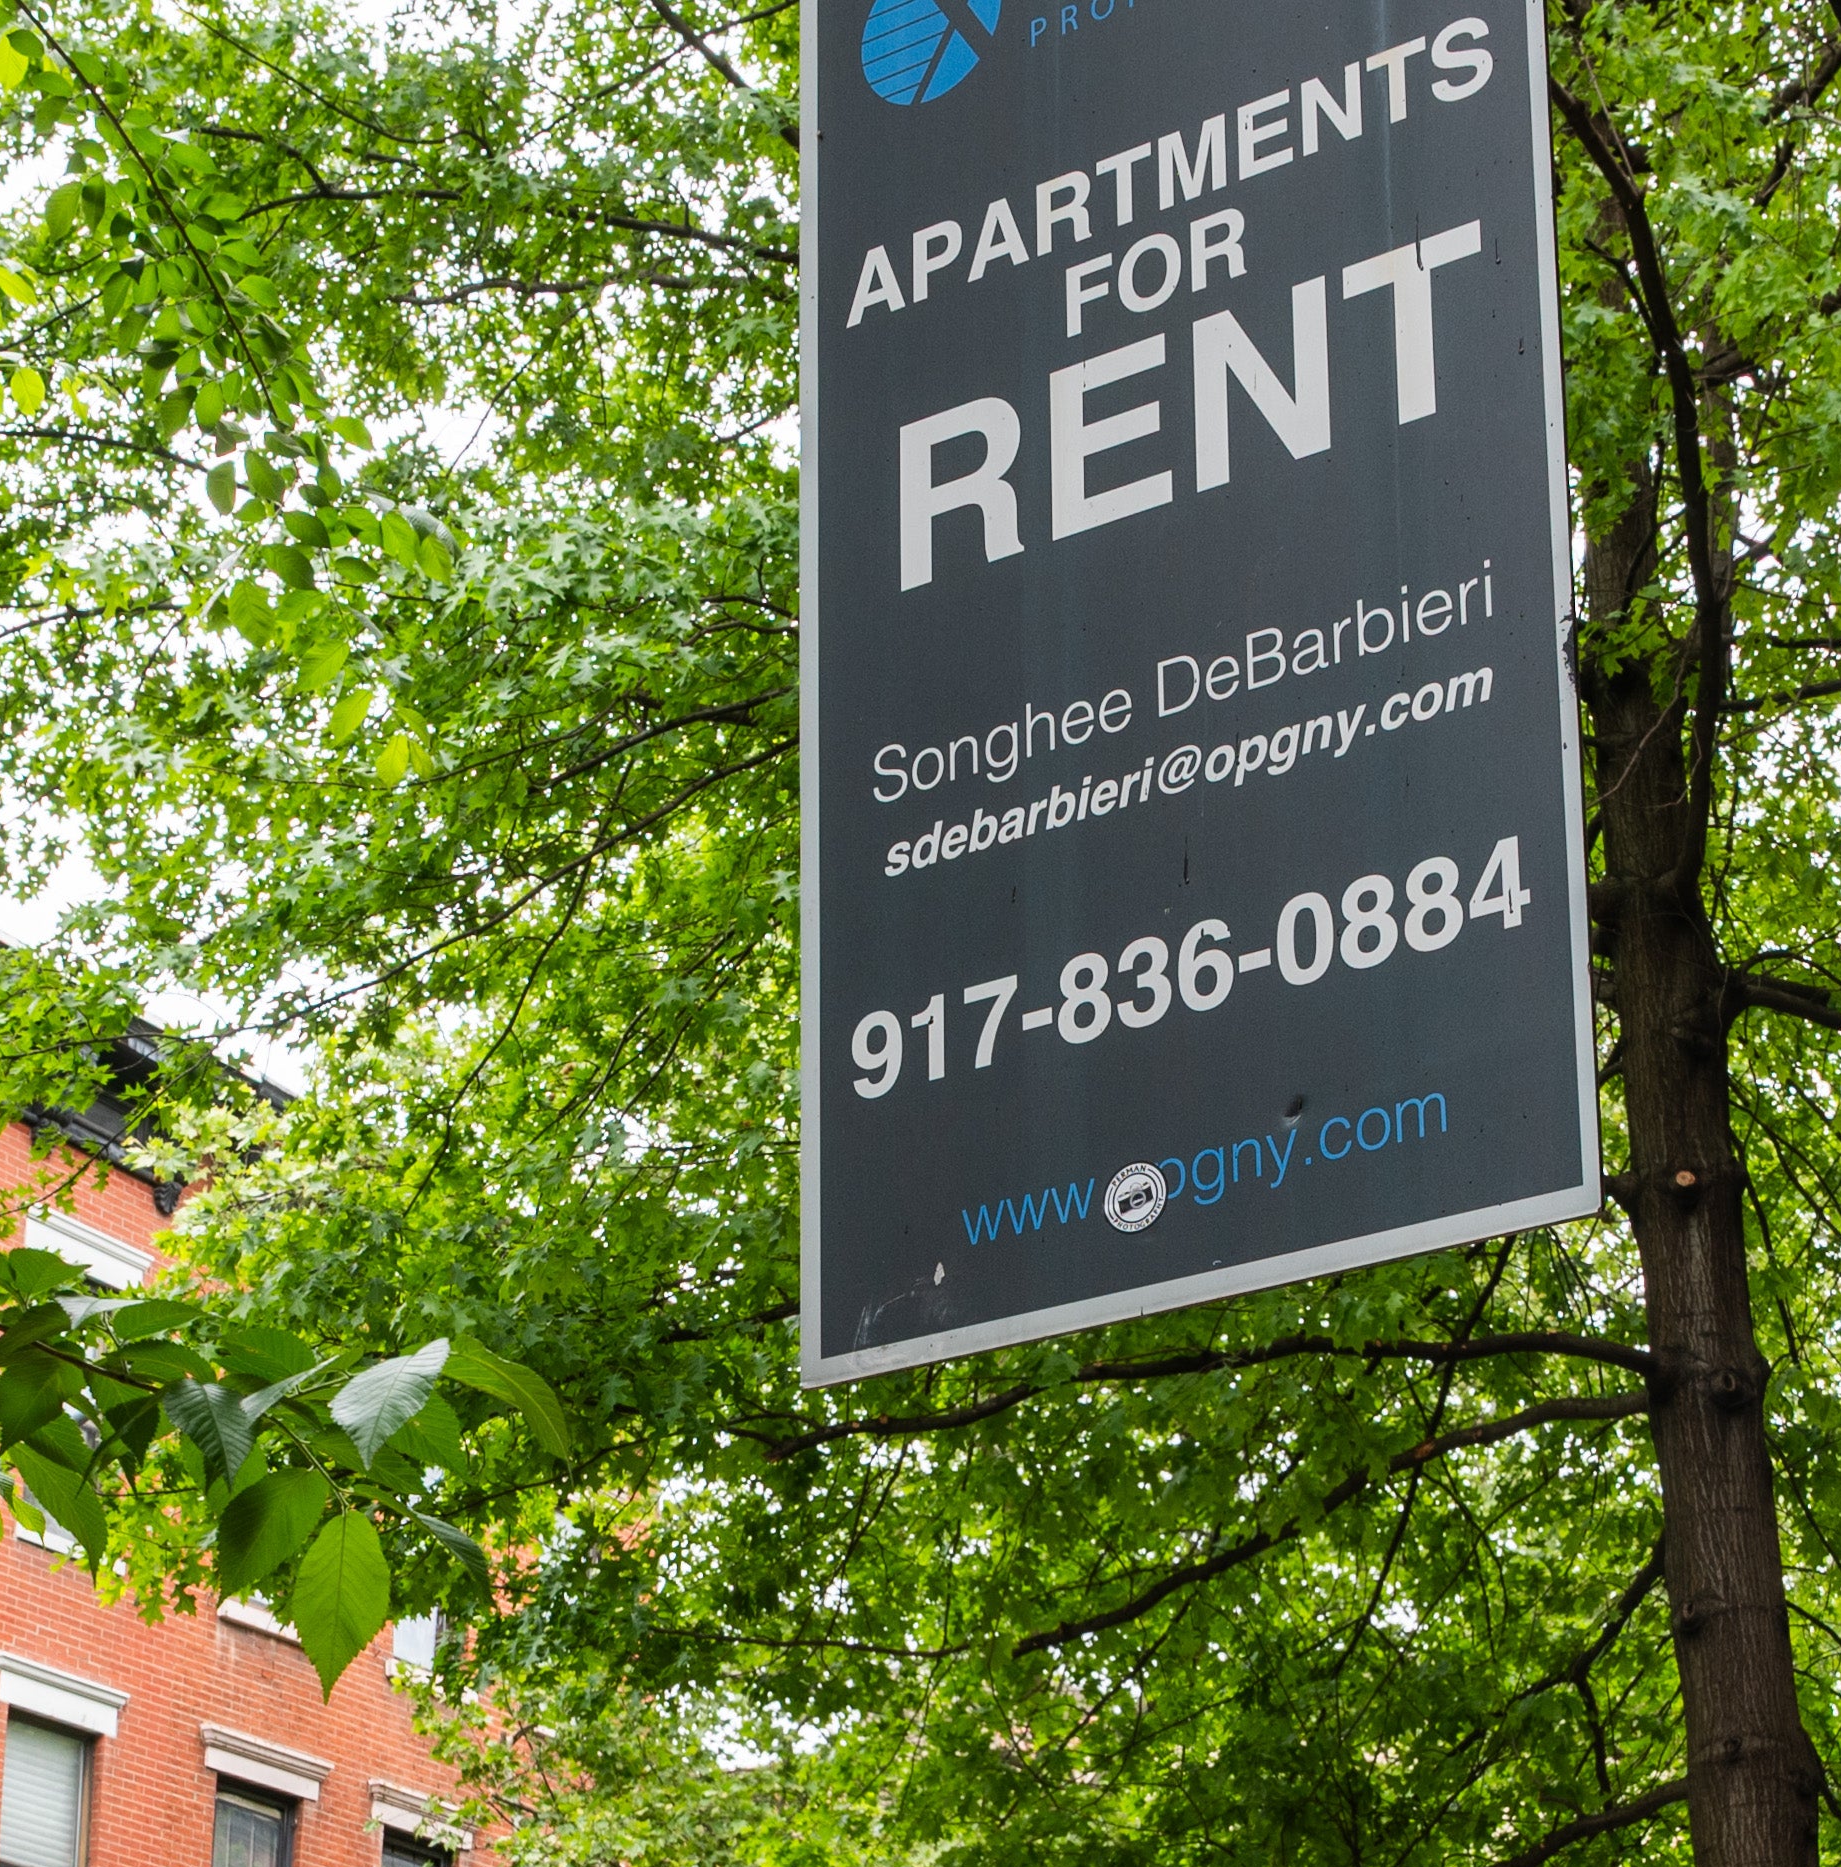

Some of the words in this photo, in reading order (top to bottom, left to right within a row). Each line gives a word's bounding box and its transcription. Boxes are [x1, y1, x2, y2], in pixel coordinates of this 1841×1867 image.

[846, 16, 1494, 329] APARTMENTS
[1065, 207, 1248, 338] FOR
[900, 219, 1482, 593] RENT
[873, 686, 1132, 802] Songhee
[1157, 560, 1494, 719] DeBarbieri
[885, 664, 1494, 878] sdebarbieri@opgny.com
[850, 835, 1531, 1100] 917-836-0884
[1112, 1165, 1146, 1187] PERMAN
[1114, 1197, 1164, 1229] PHOTOGRAPHY
